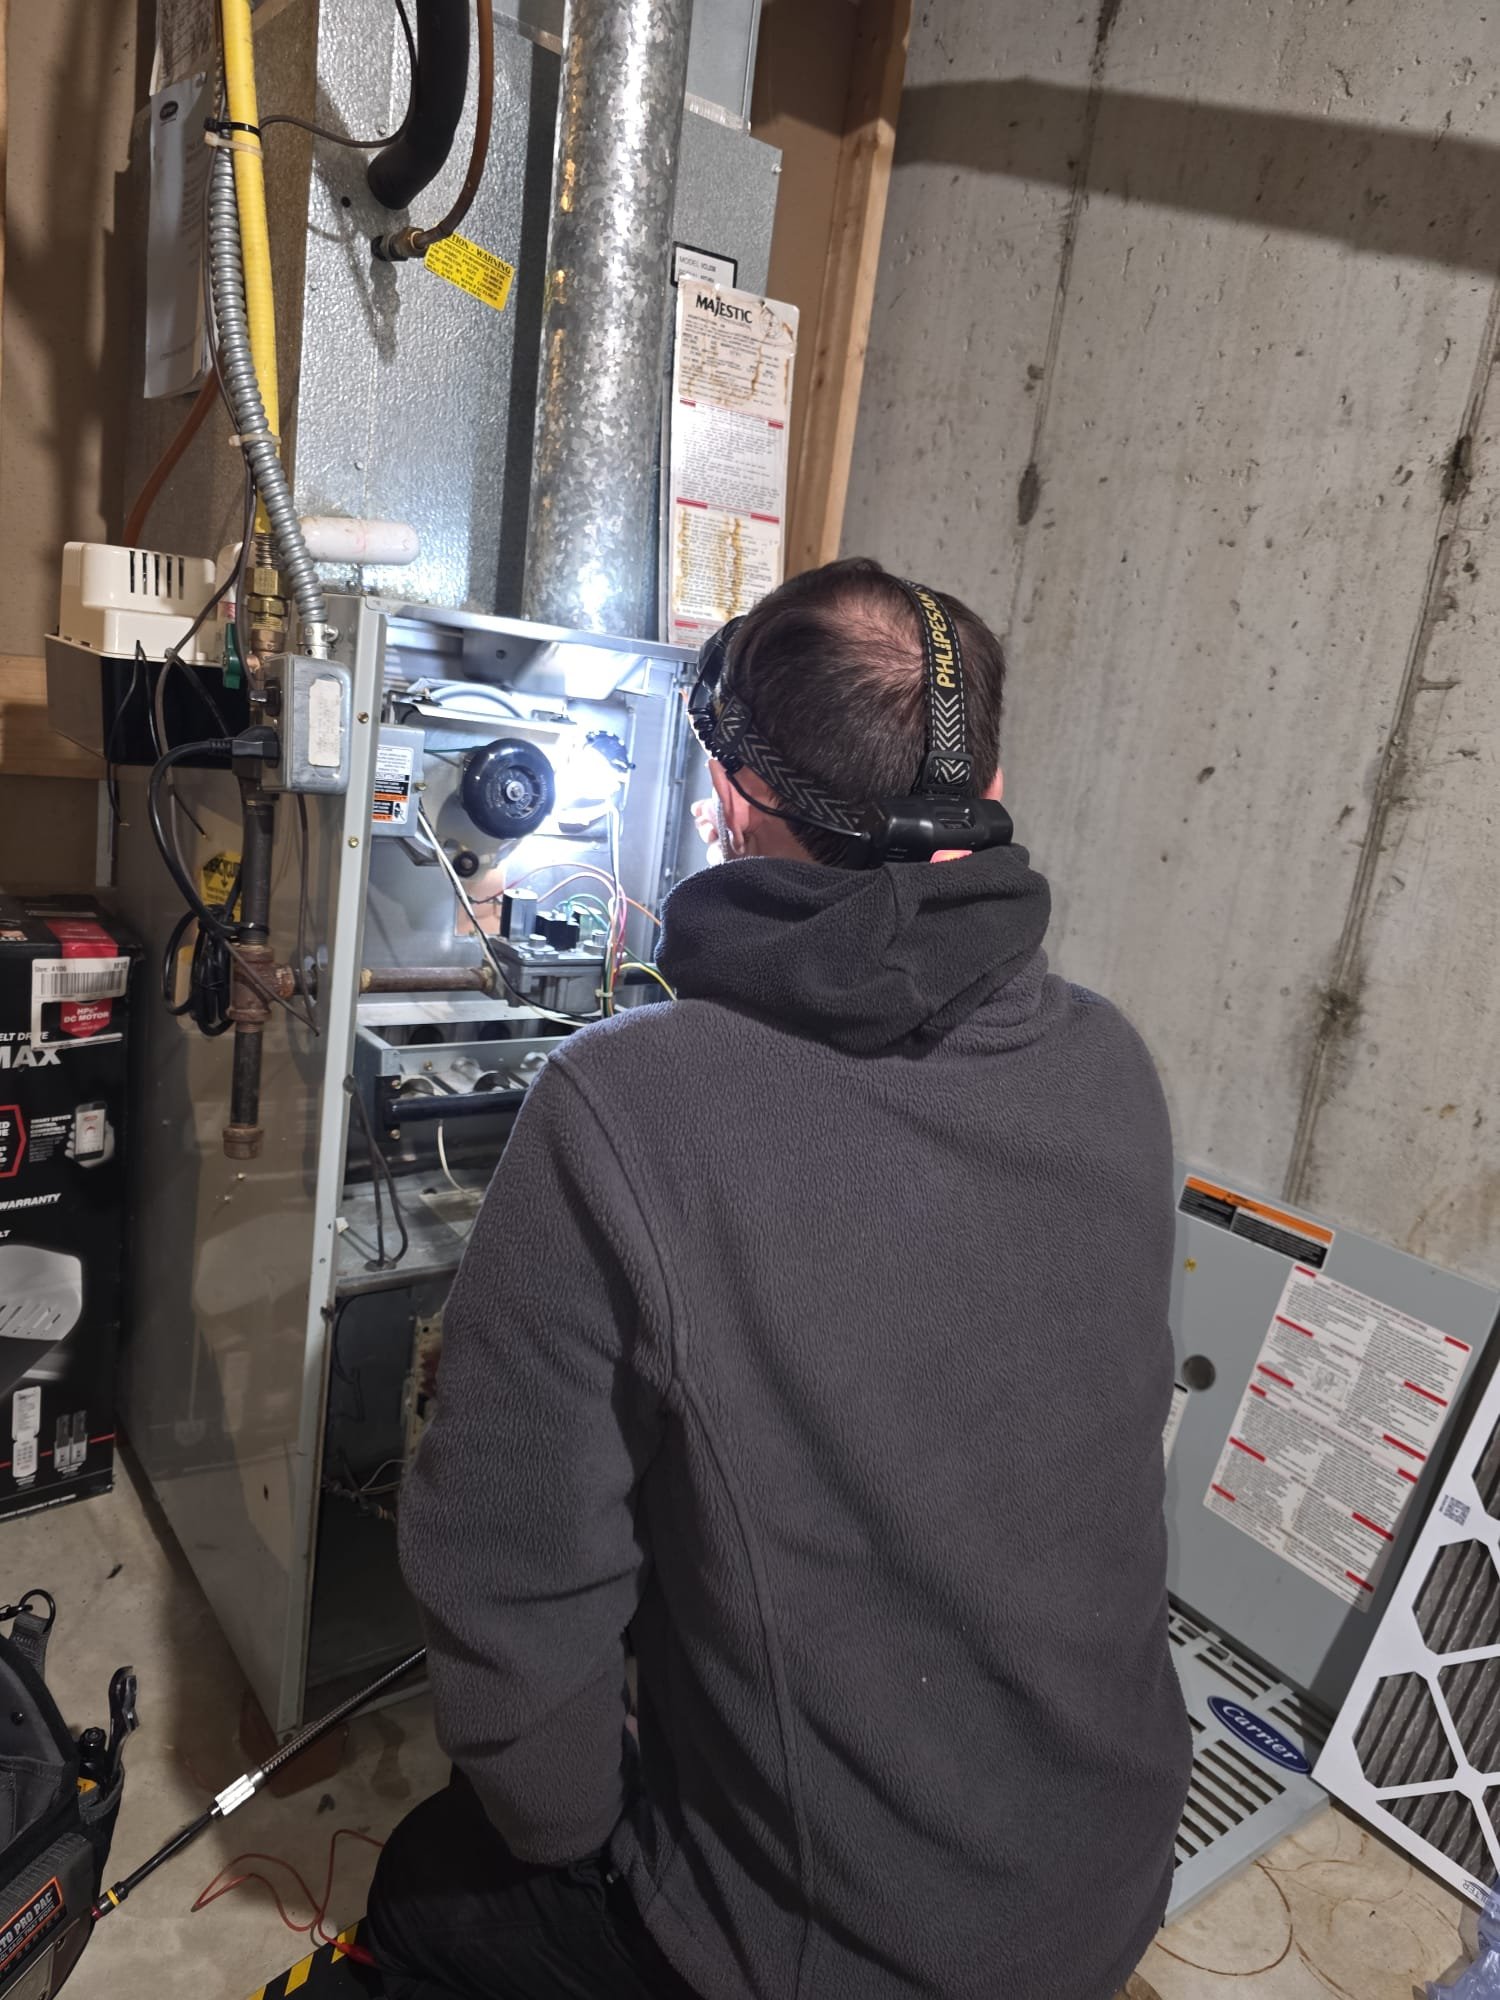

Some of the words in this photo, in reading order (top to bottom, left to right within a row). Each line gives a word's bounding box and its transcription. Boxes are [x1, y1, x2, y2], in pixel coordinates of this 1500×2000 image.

[476, 249, 511, 274] WARNING
[696, 294, 752, 324] MAJESTIC
[64, 1015, 76, 1023] DC
[78, 1011, 109, 1022] MOTOR
[18, 1032, 49, 1040] DRE
[0, 1193, 61, 1210] WARRANTY
[1222, 1705, 1298, 1760] Carrier
[13, 1912, 34, 1935] PRO
[33, 1892, 53, 1914] PAC
